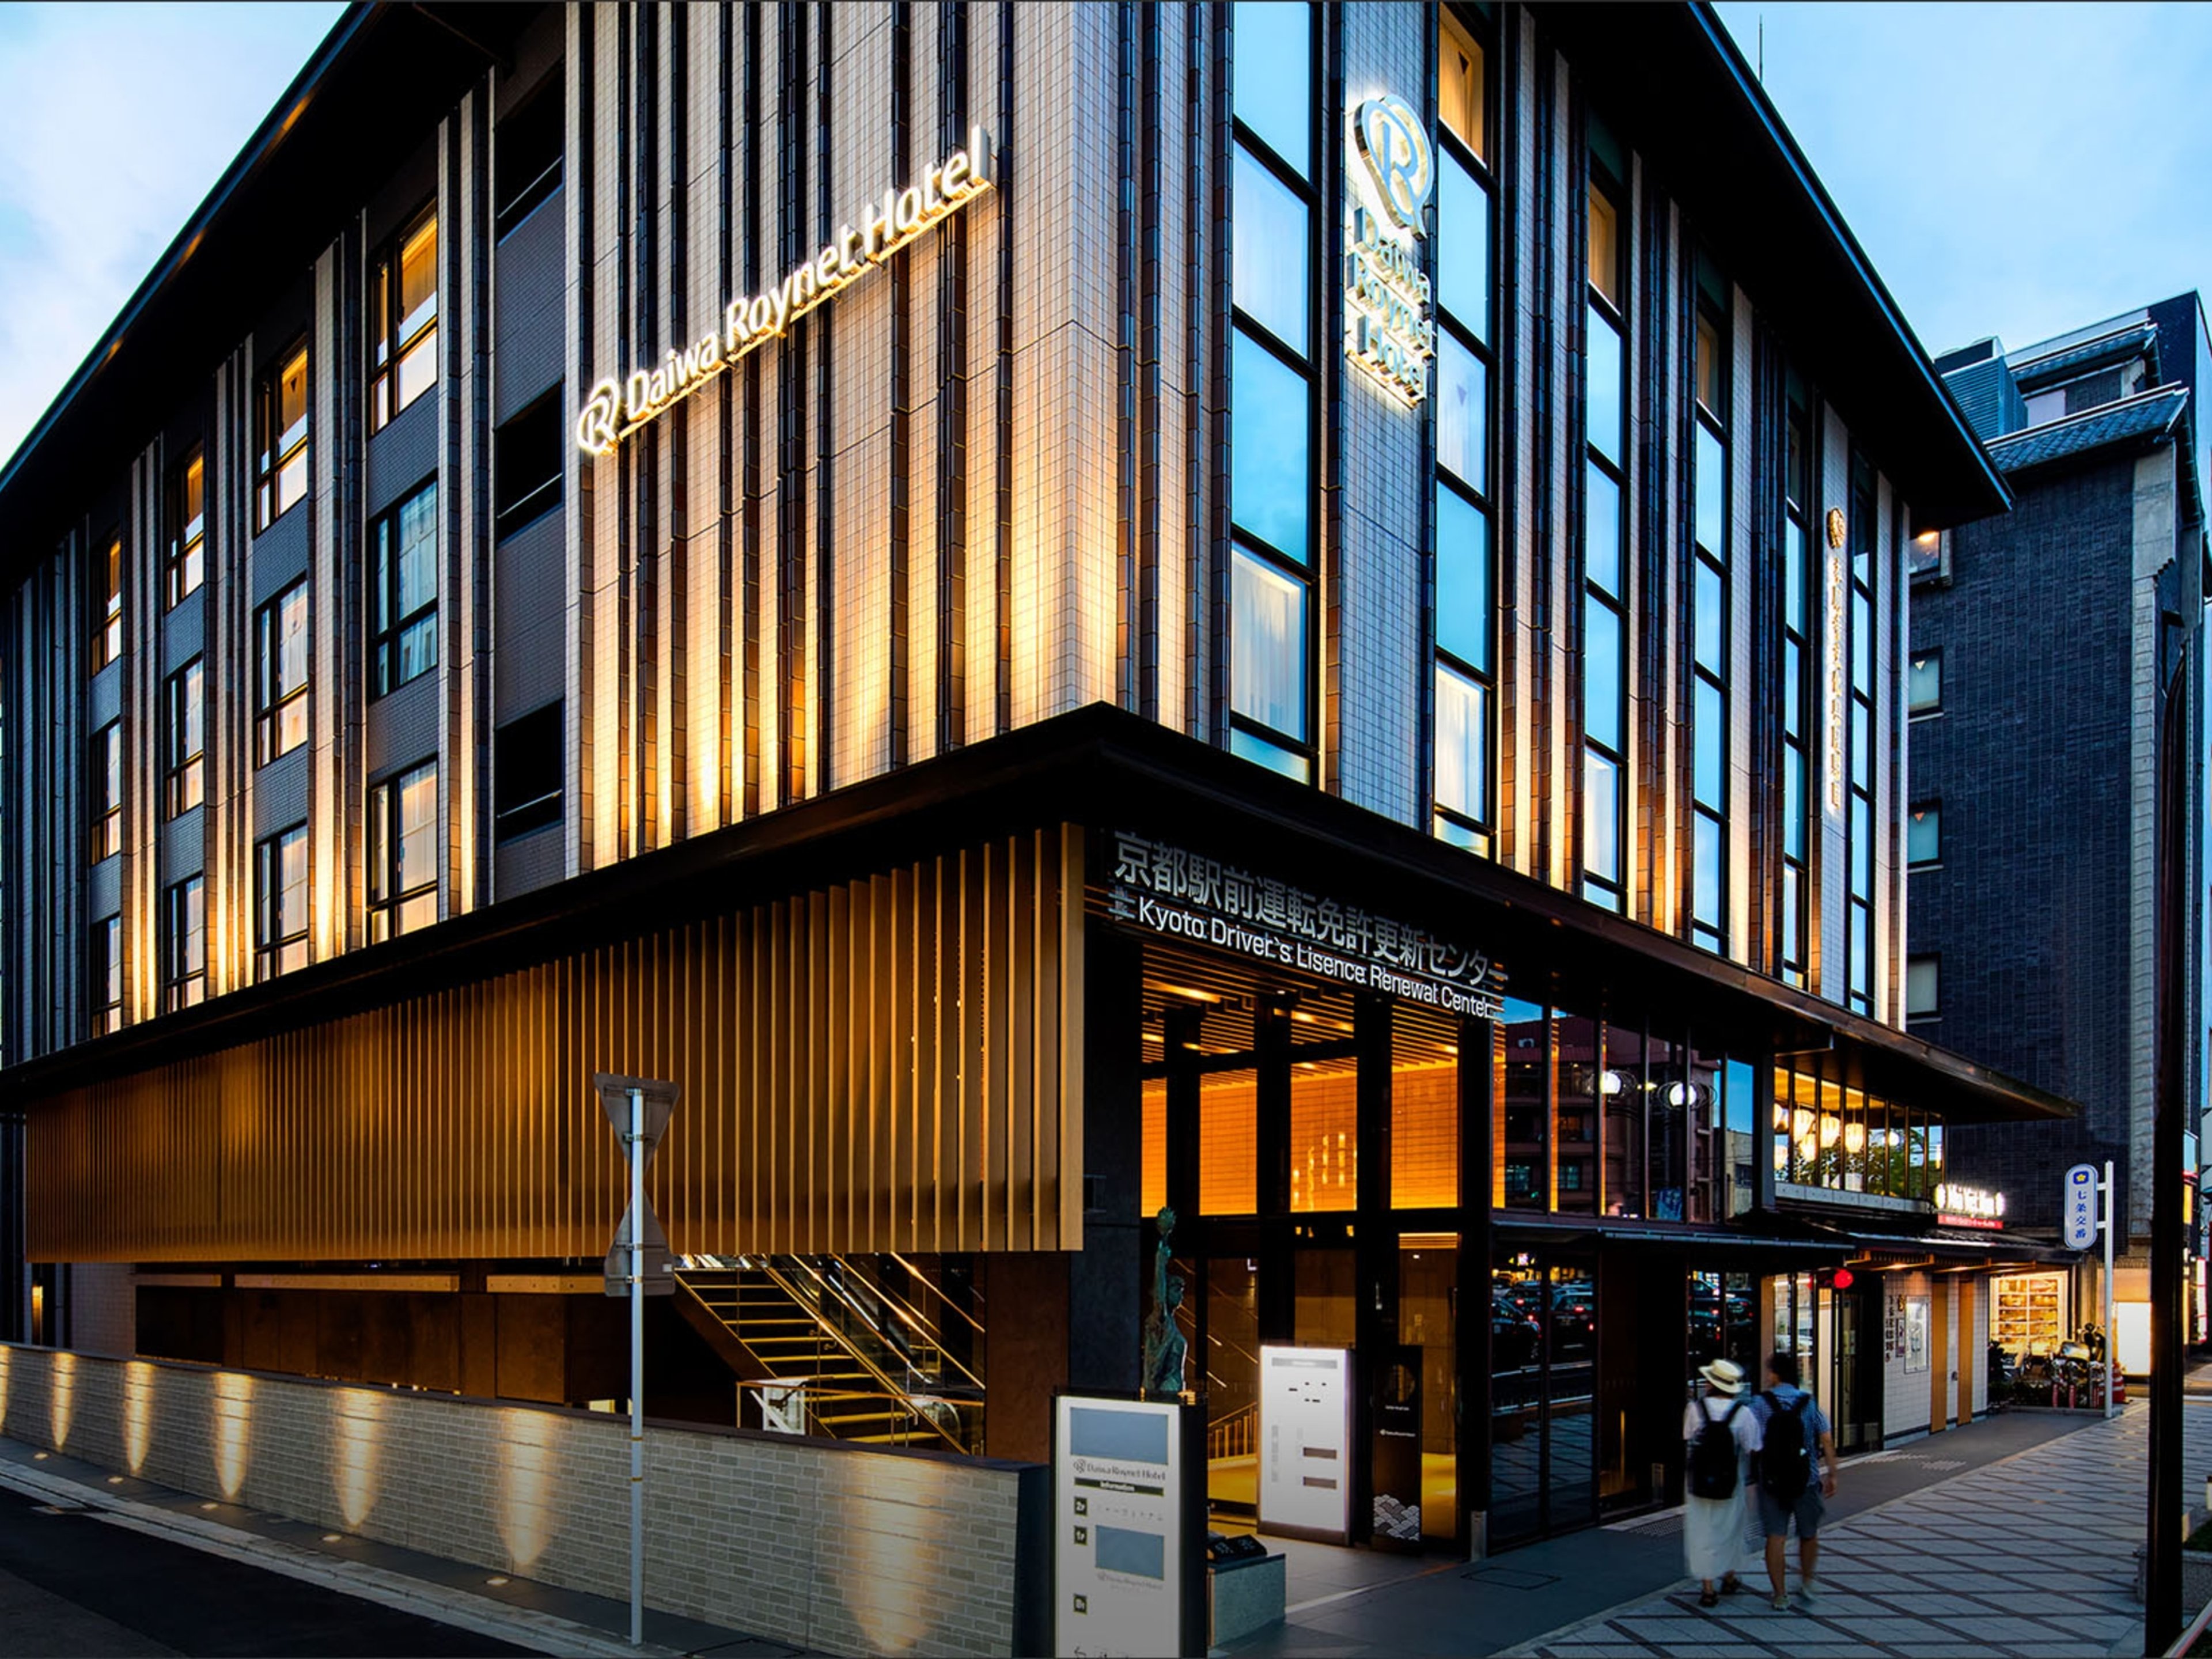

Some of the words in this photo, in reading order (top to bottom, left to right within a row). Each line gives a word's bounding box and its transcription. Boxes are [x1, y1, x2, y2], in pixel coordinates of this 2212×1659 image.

[626, 332, 722, 421] Daiwa
[726, 223, 858, 353] Roynet
[864, 124, 988, 257] Hotel
[1347, 251, 1436, 357] Roynet
[1355, 206, 1430, 304] Daiwa
[1358, 314, 1427, 400] Hotel
[1114, 831, 1508, 985] 京都駅前運転免許更新センター
[1139, 896, 1205, 938] Kyoto
[1297, 942, 1366, 984] Lisence
[1370, 964, 1438, 1004] Renewal
[1441, 986, 1498, 1018] Center
